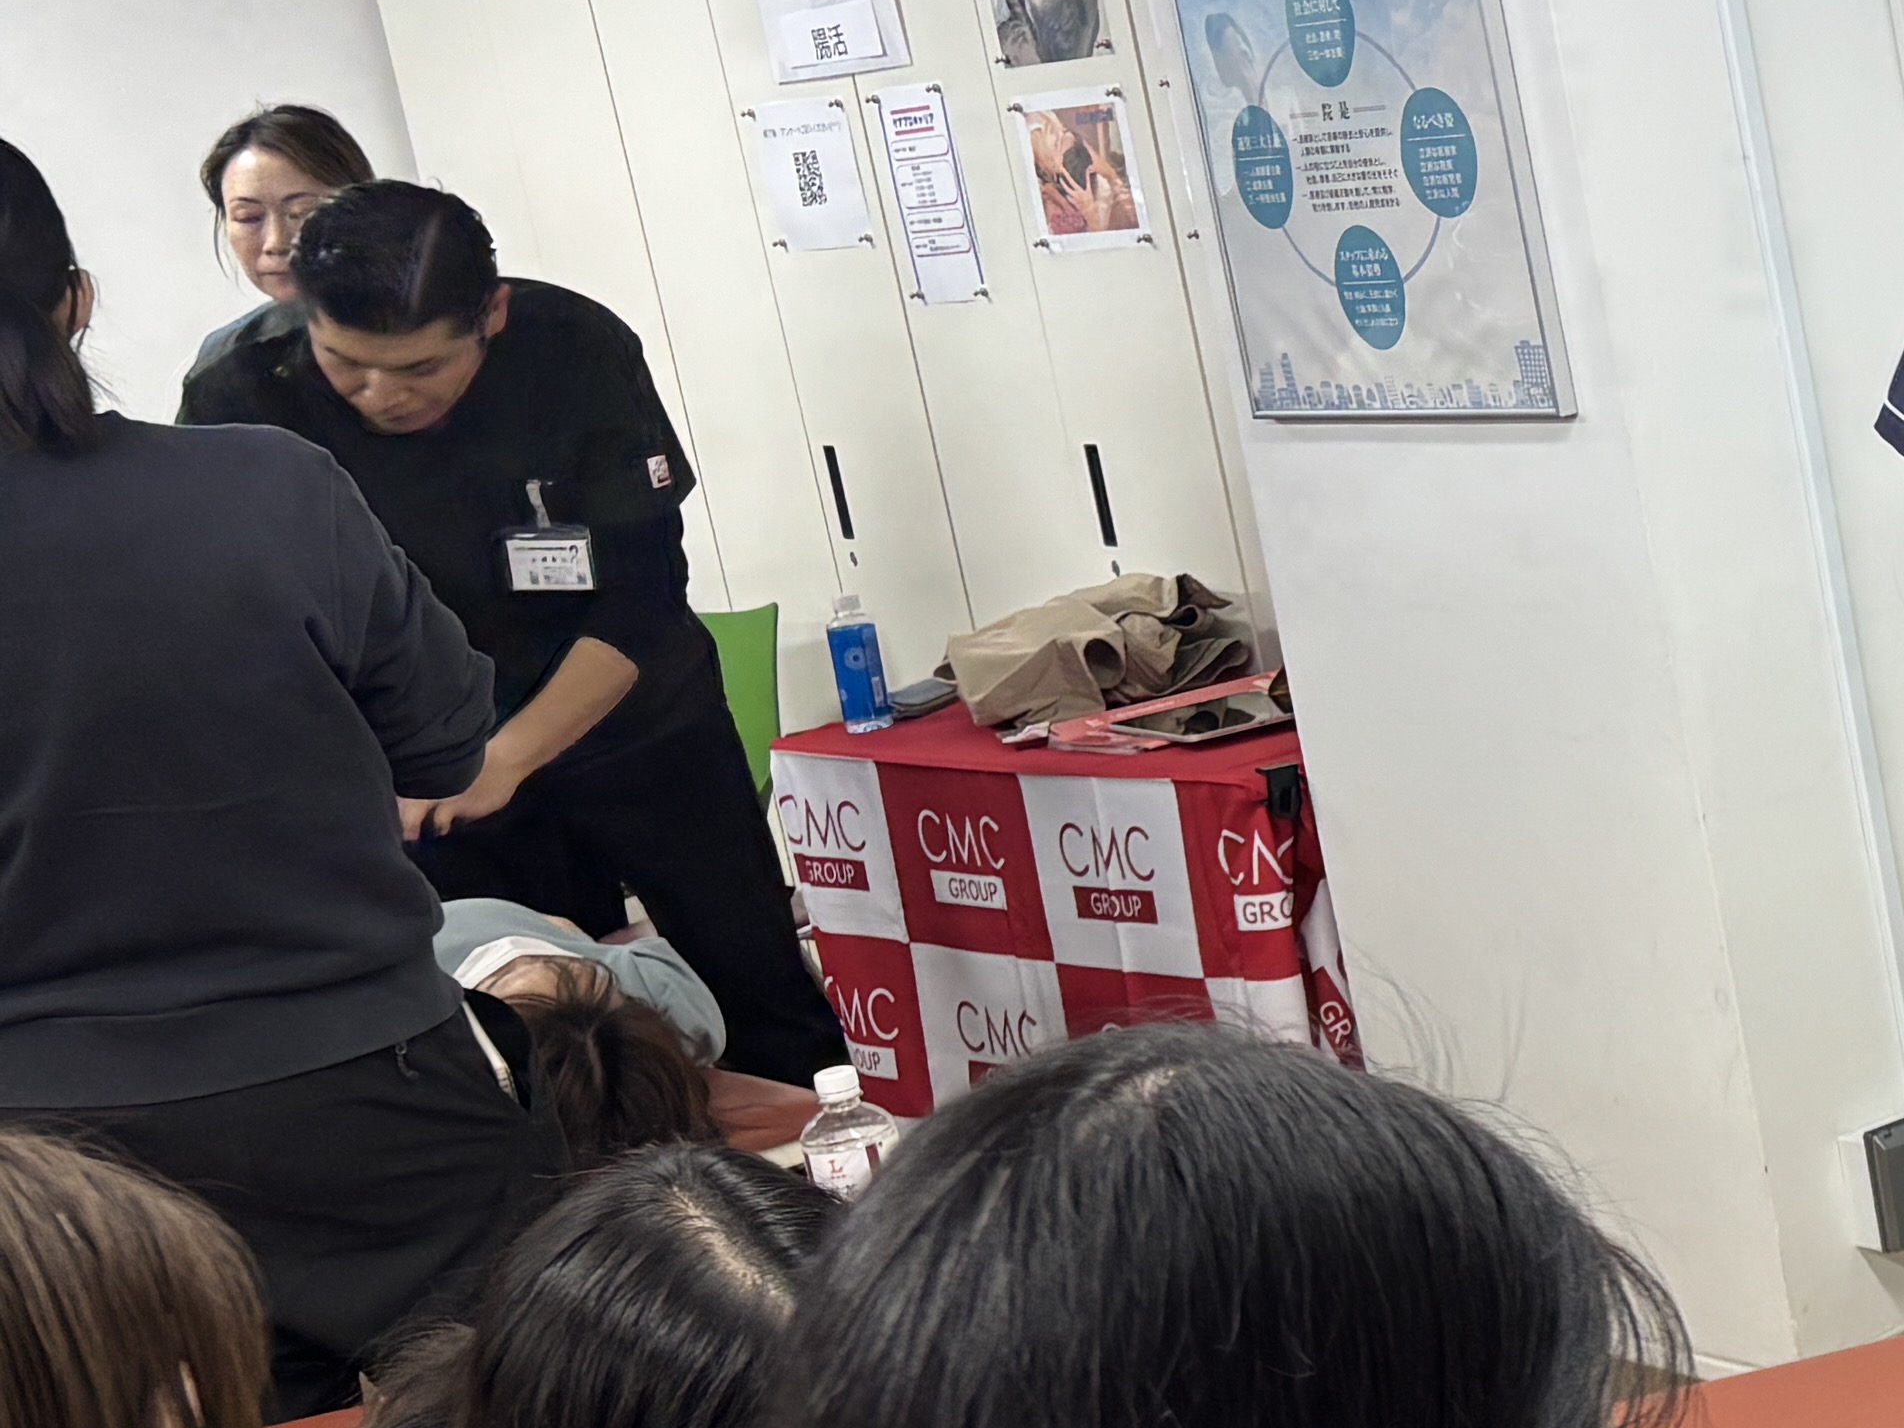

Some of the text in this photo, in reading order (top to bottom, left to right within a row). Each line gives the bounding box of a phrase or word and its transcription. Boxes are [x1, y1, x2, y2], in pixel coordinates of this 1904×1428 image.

[779, 794, 866, 852] CMC
[917, 809, 1005, 870] CMC
[1058, 822, 1155, 882] CMC
[949, 877, 998, 903] GROUP
[1091, 892, 1142, 917] GROUP
